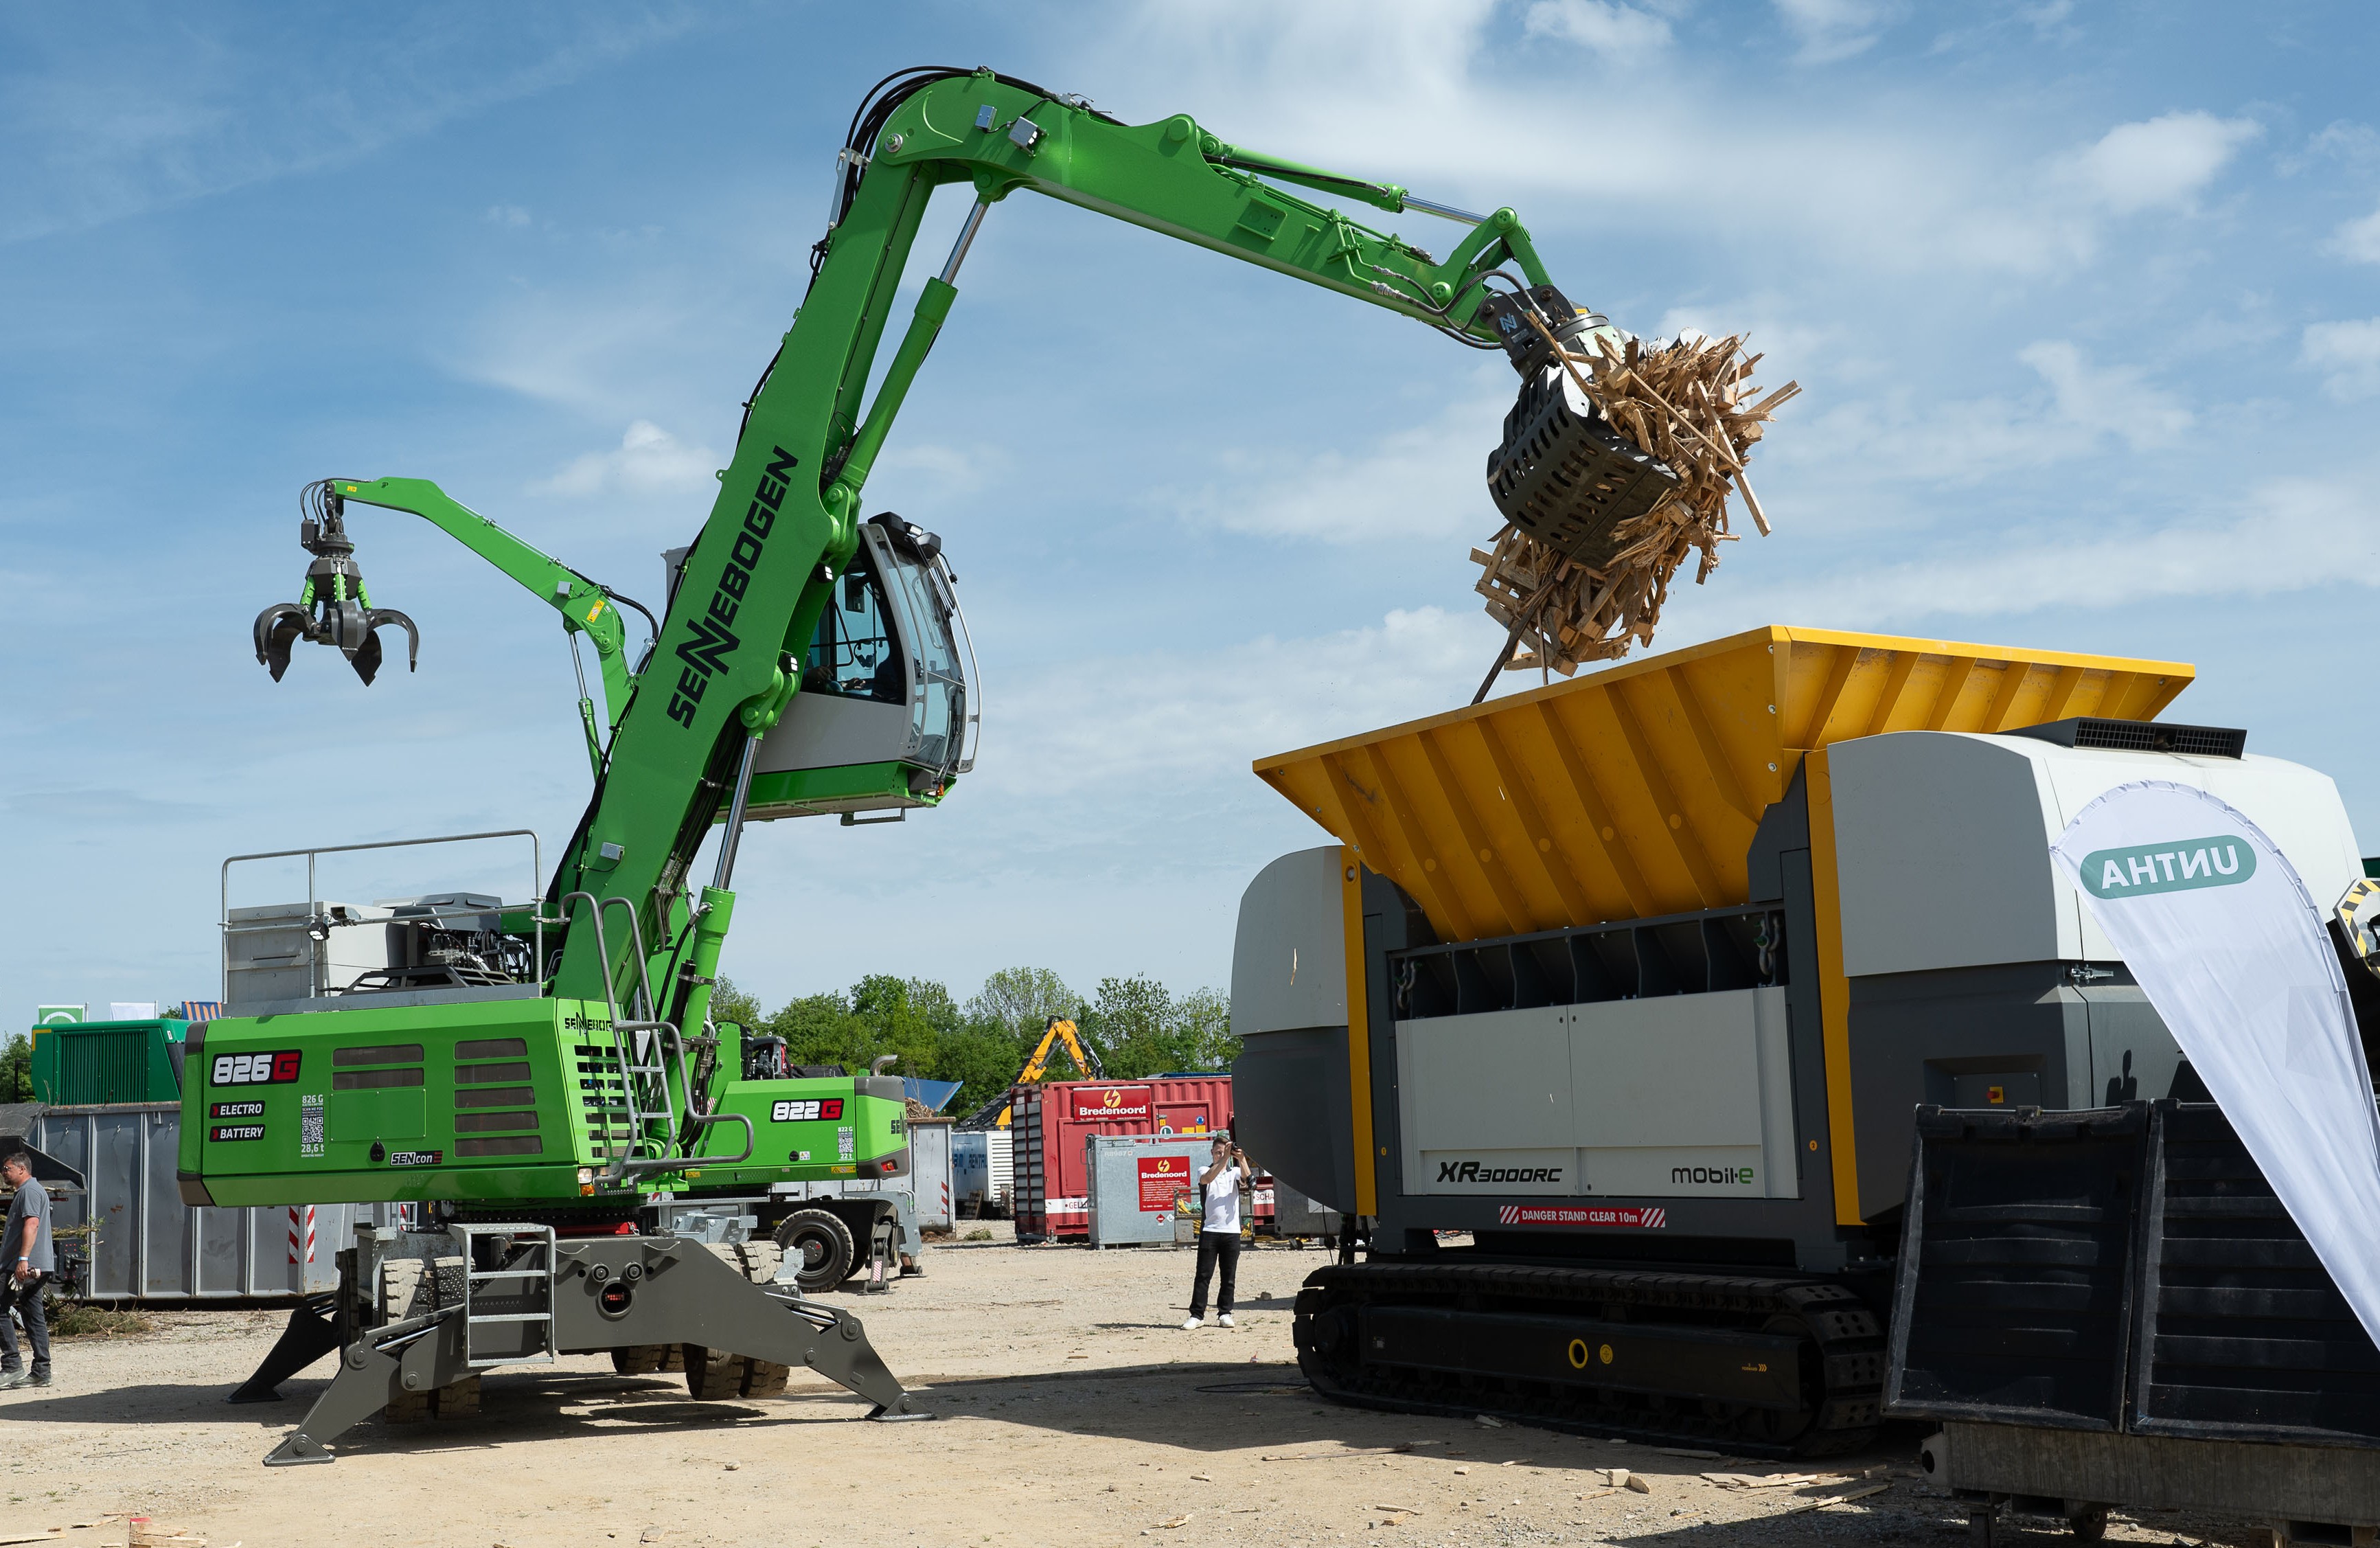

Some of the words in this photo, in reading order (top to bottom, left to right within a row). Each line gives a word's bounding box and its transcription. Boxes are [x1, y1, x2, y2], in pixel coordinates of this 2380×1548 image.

[666, 445, 799, 729] SENNEBOGEN
[564, 1012, 613, 1036] SENNEBOG
[302, 1095, 316, 1104] 826
[318, 1094, 323, 1103] G
[220, 1103, 262, 1115] ELECTRO
[1079, 1105, 1146, 1115] Bredenoord
[220, 1127, 264, 1139] BATTERY
[301, 1143, 319, 1154] 28,6
[320, 1143, 324, 1152] t
[1437, 1161, 1563, 1183] XR3000RC
[1522, 1210, 1557, 1220] DANGER
[1559, 1211, 1587, 1221] STAND
[1589, 1211, 1616, 1222] CLEAR
[1618, 1212, 1638, 1223] 10m
